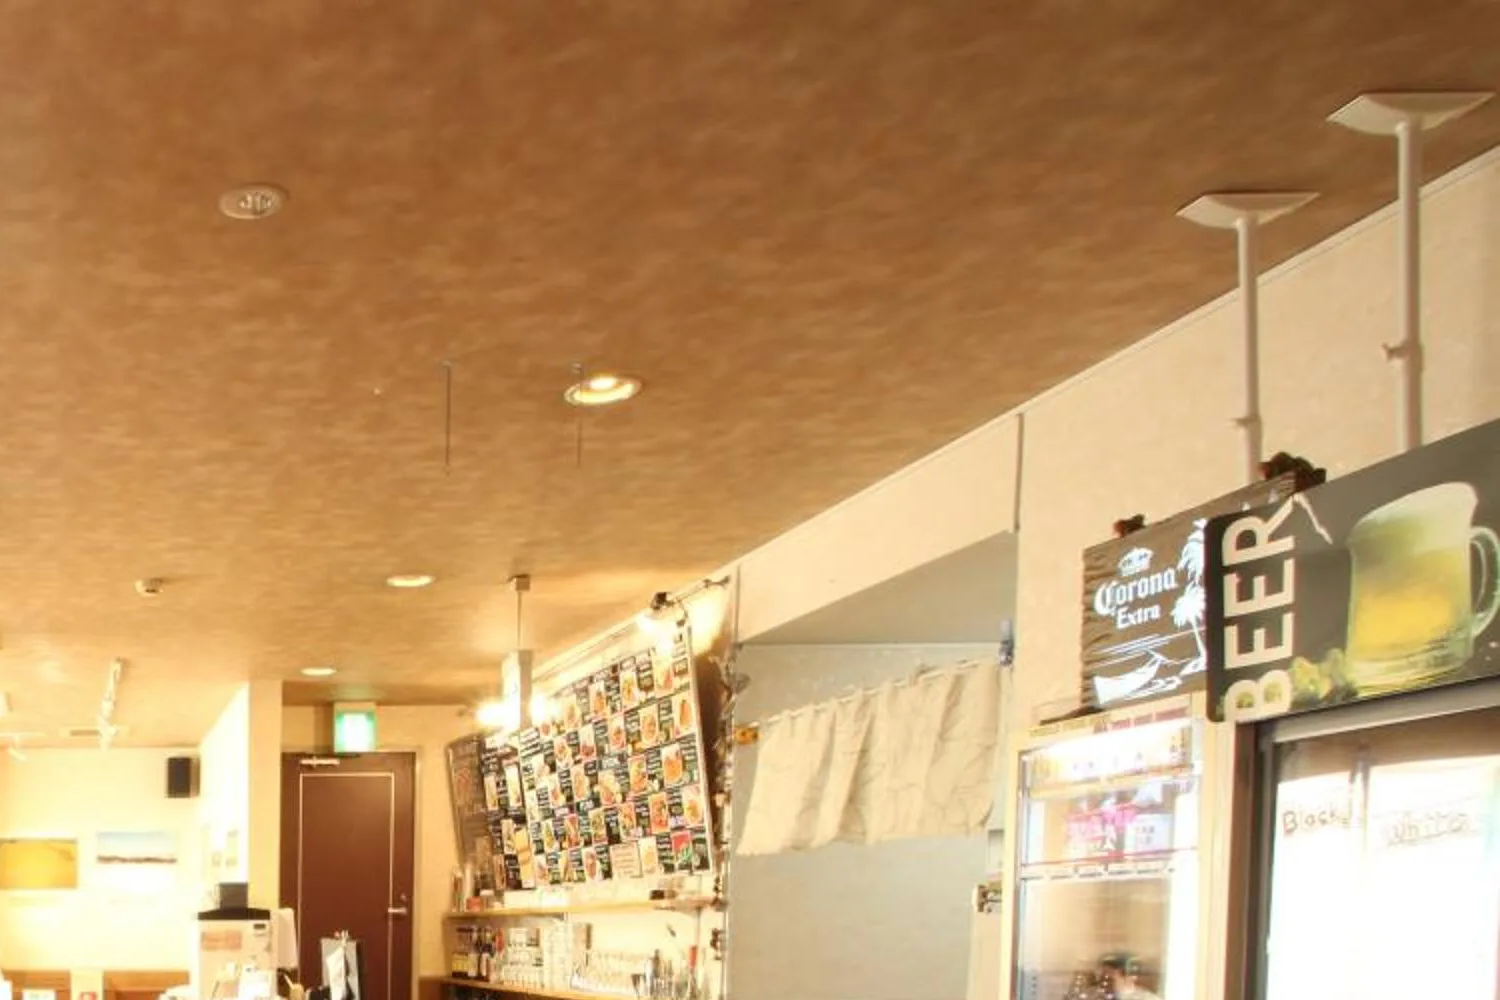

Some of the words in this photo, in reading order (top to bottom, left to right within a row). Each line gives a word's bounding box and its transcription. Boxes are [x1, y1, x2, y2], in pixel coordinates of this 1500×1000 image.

[1094, 567, 1179, 617] Corona
[1117, 604, 1162, 630] Extra
[1222, 496, 1295, 725] BEER
